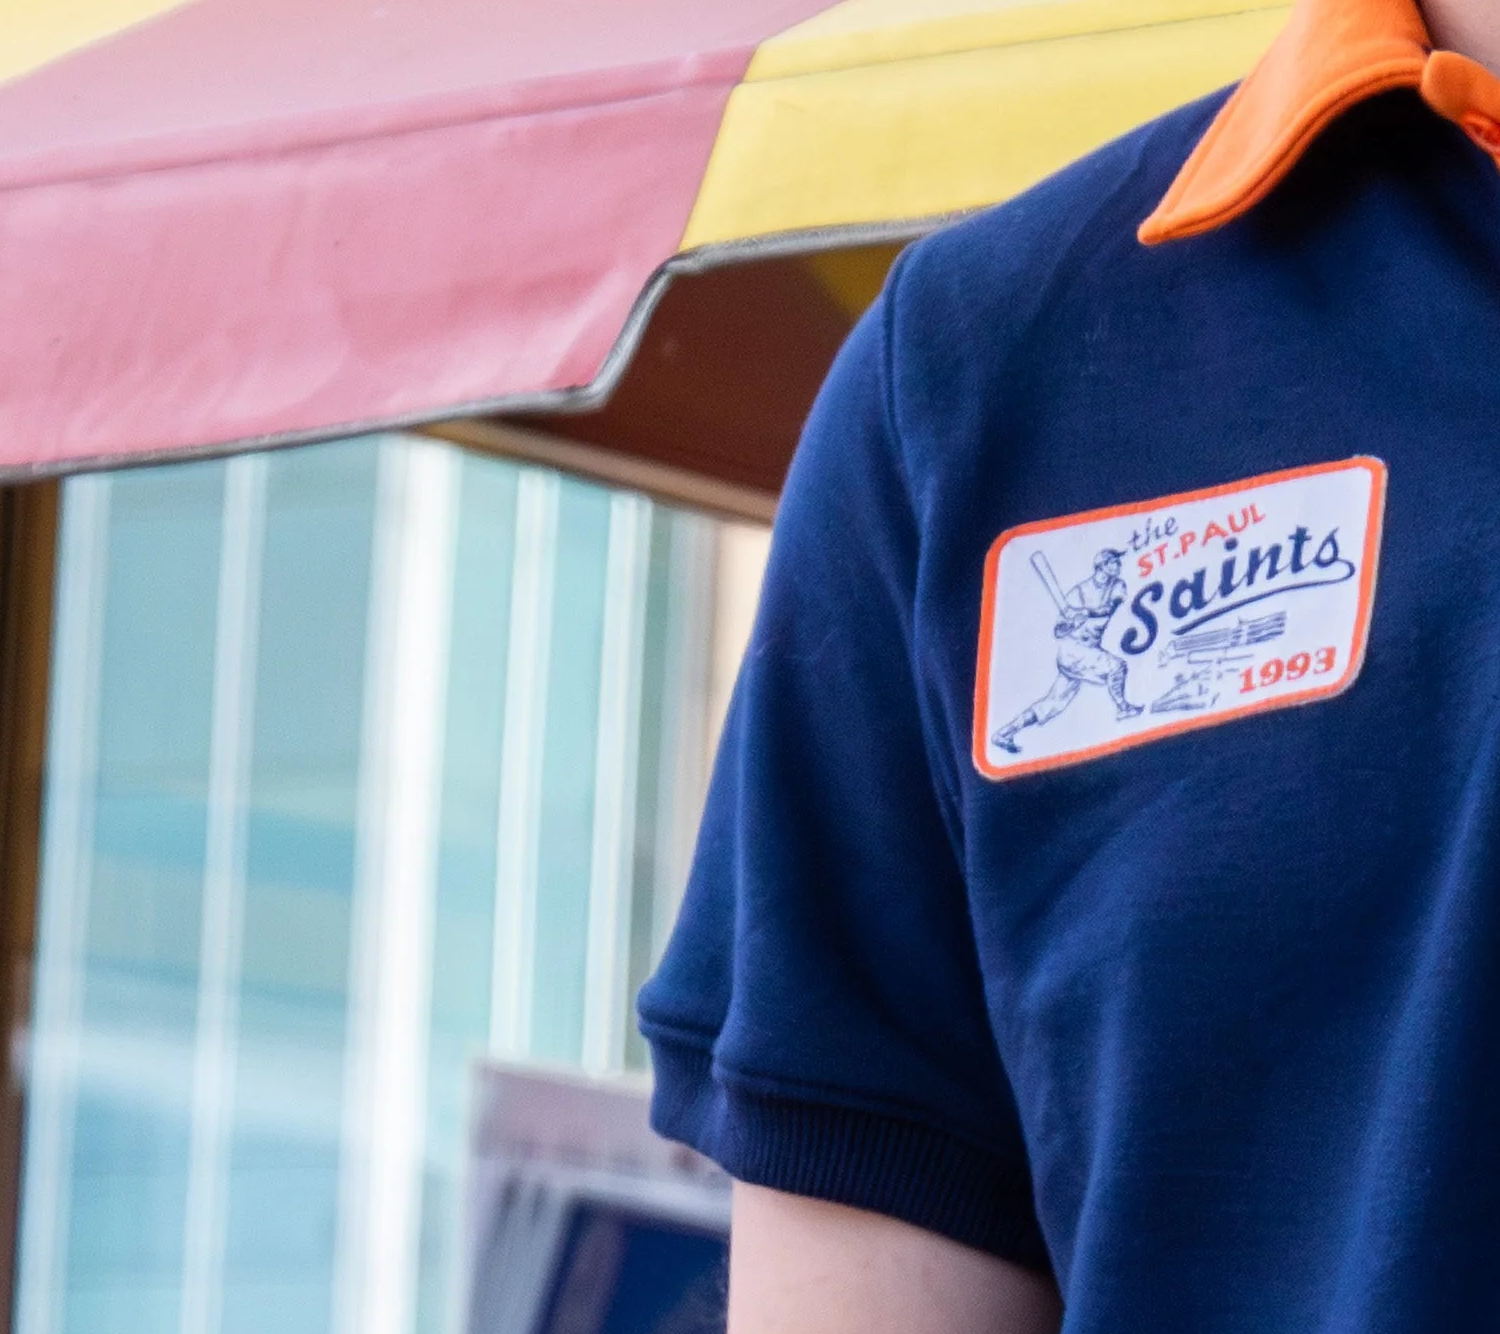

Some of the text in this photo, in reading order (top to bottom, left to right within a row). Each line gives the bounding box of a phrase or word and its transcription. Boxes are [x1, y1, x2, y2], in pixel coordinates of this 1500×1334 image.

[1127, 517, 1179, 552] the
[1121, 525, 1355, 655] Saints
[1239, 646, 1336, 693] 1993
